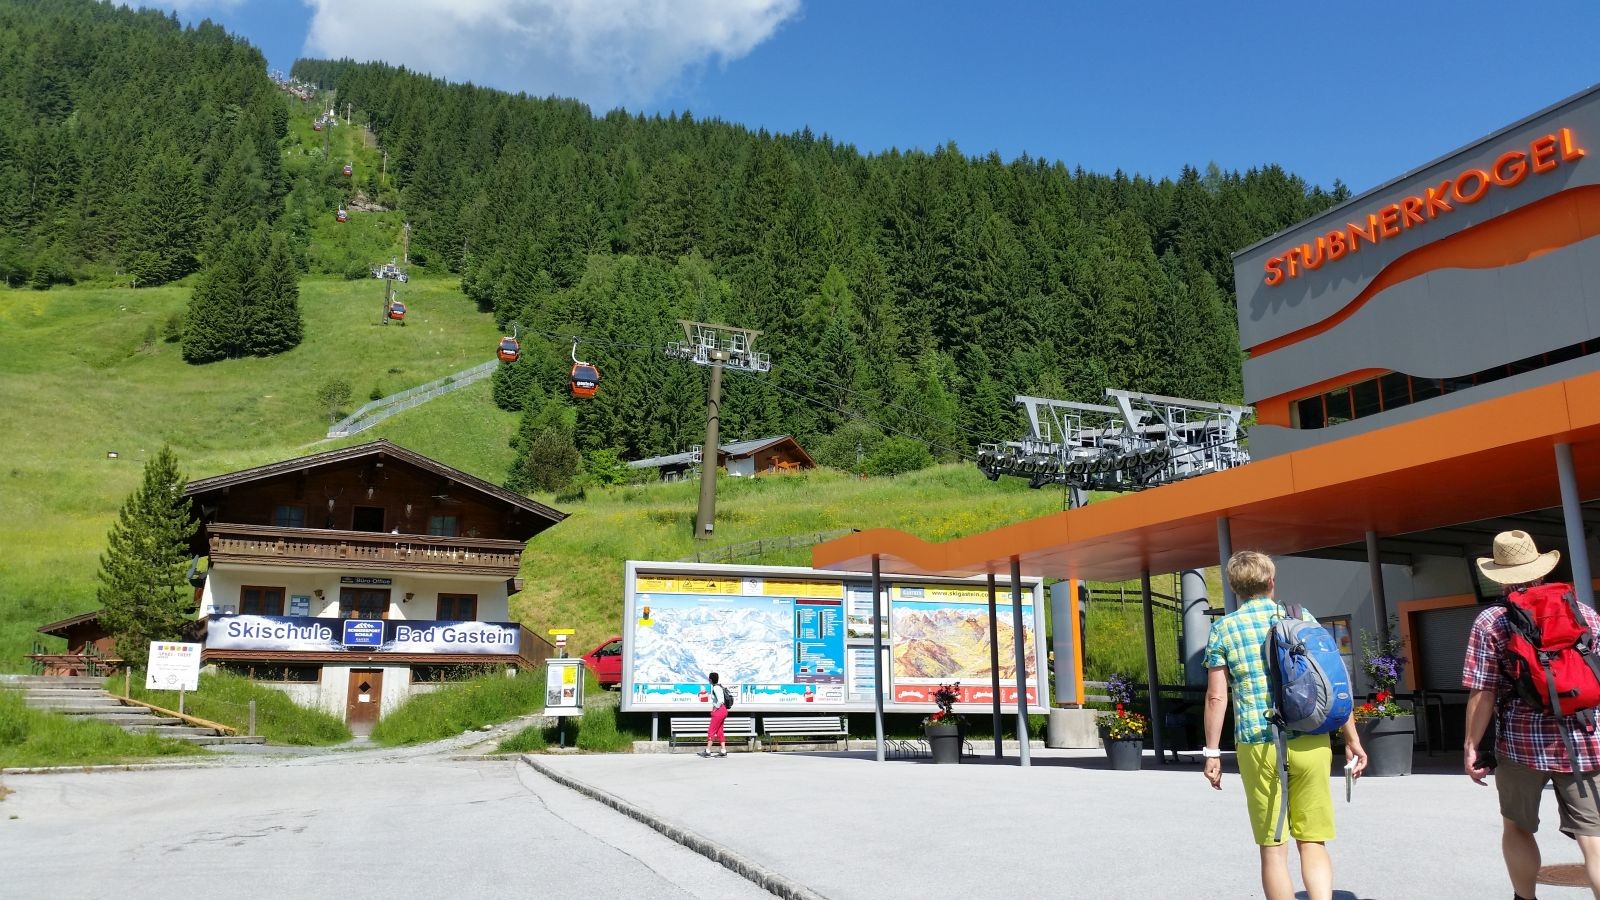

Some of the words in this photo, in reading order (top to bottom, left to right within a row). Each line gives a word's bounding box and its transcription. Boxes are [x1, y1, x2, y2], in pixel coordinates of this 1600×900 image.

[1264, 127, 1586, 287] STUBNERKOGEL
[931, 590, 989, 598] www.skigastein.co
[227, 621, 332, 641] Skischule
[397, 626, 435, 643] Bad
[442, 628, 514, 645] Gastein
